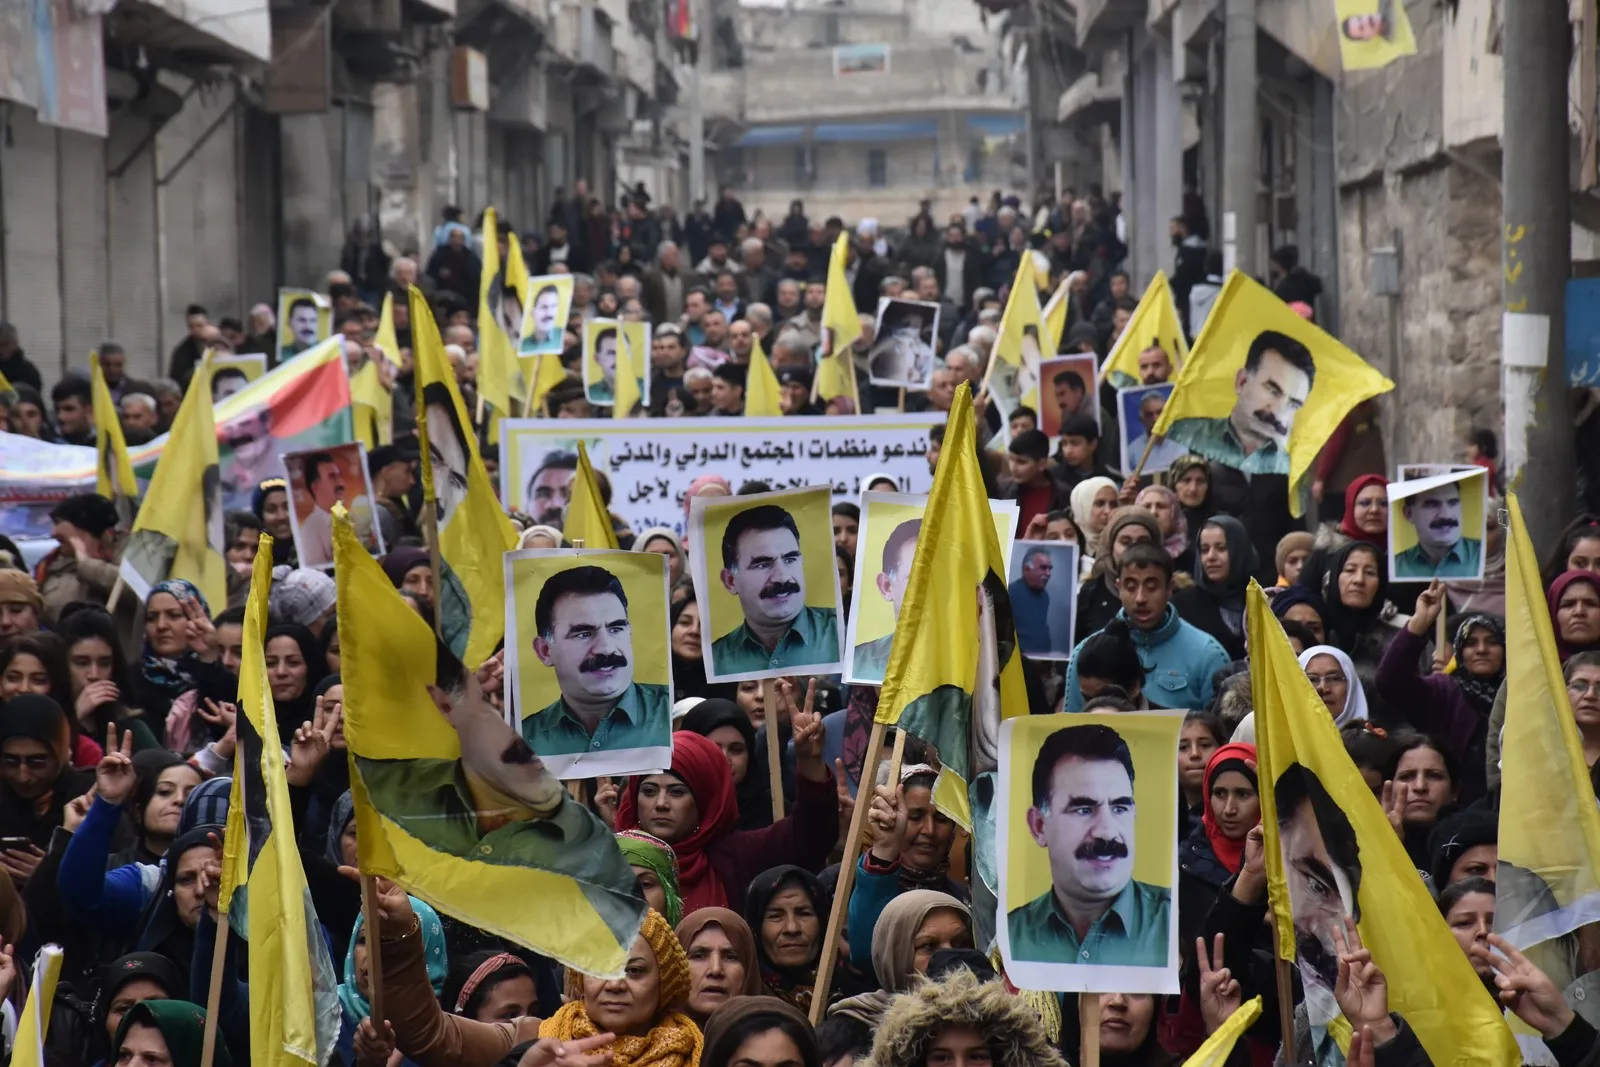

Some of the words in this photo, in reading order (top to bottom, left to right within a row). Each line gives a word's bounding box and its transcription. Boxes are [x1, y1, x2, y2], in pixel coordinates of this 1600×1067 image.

[609, 441, 671, 472] والمدني
[675, 442, 737, 471] الدولي
[741, 440, 804, 468] المجتمع
[808, 439, 877, 459] منظمات
[881, 437, 927, 463] ندعو
